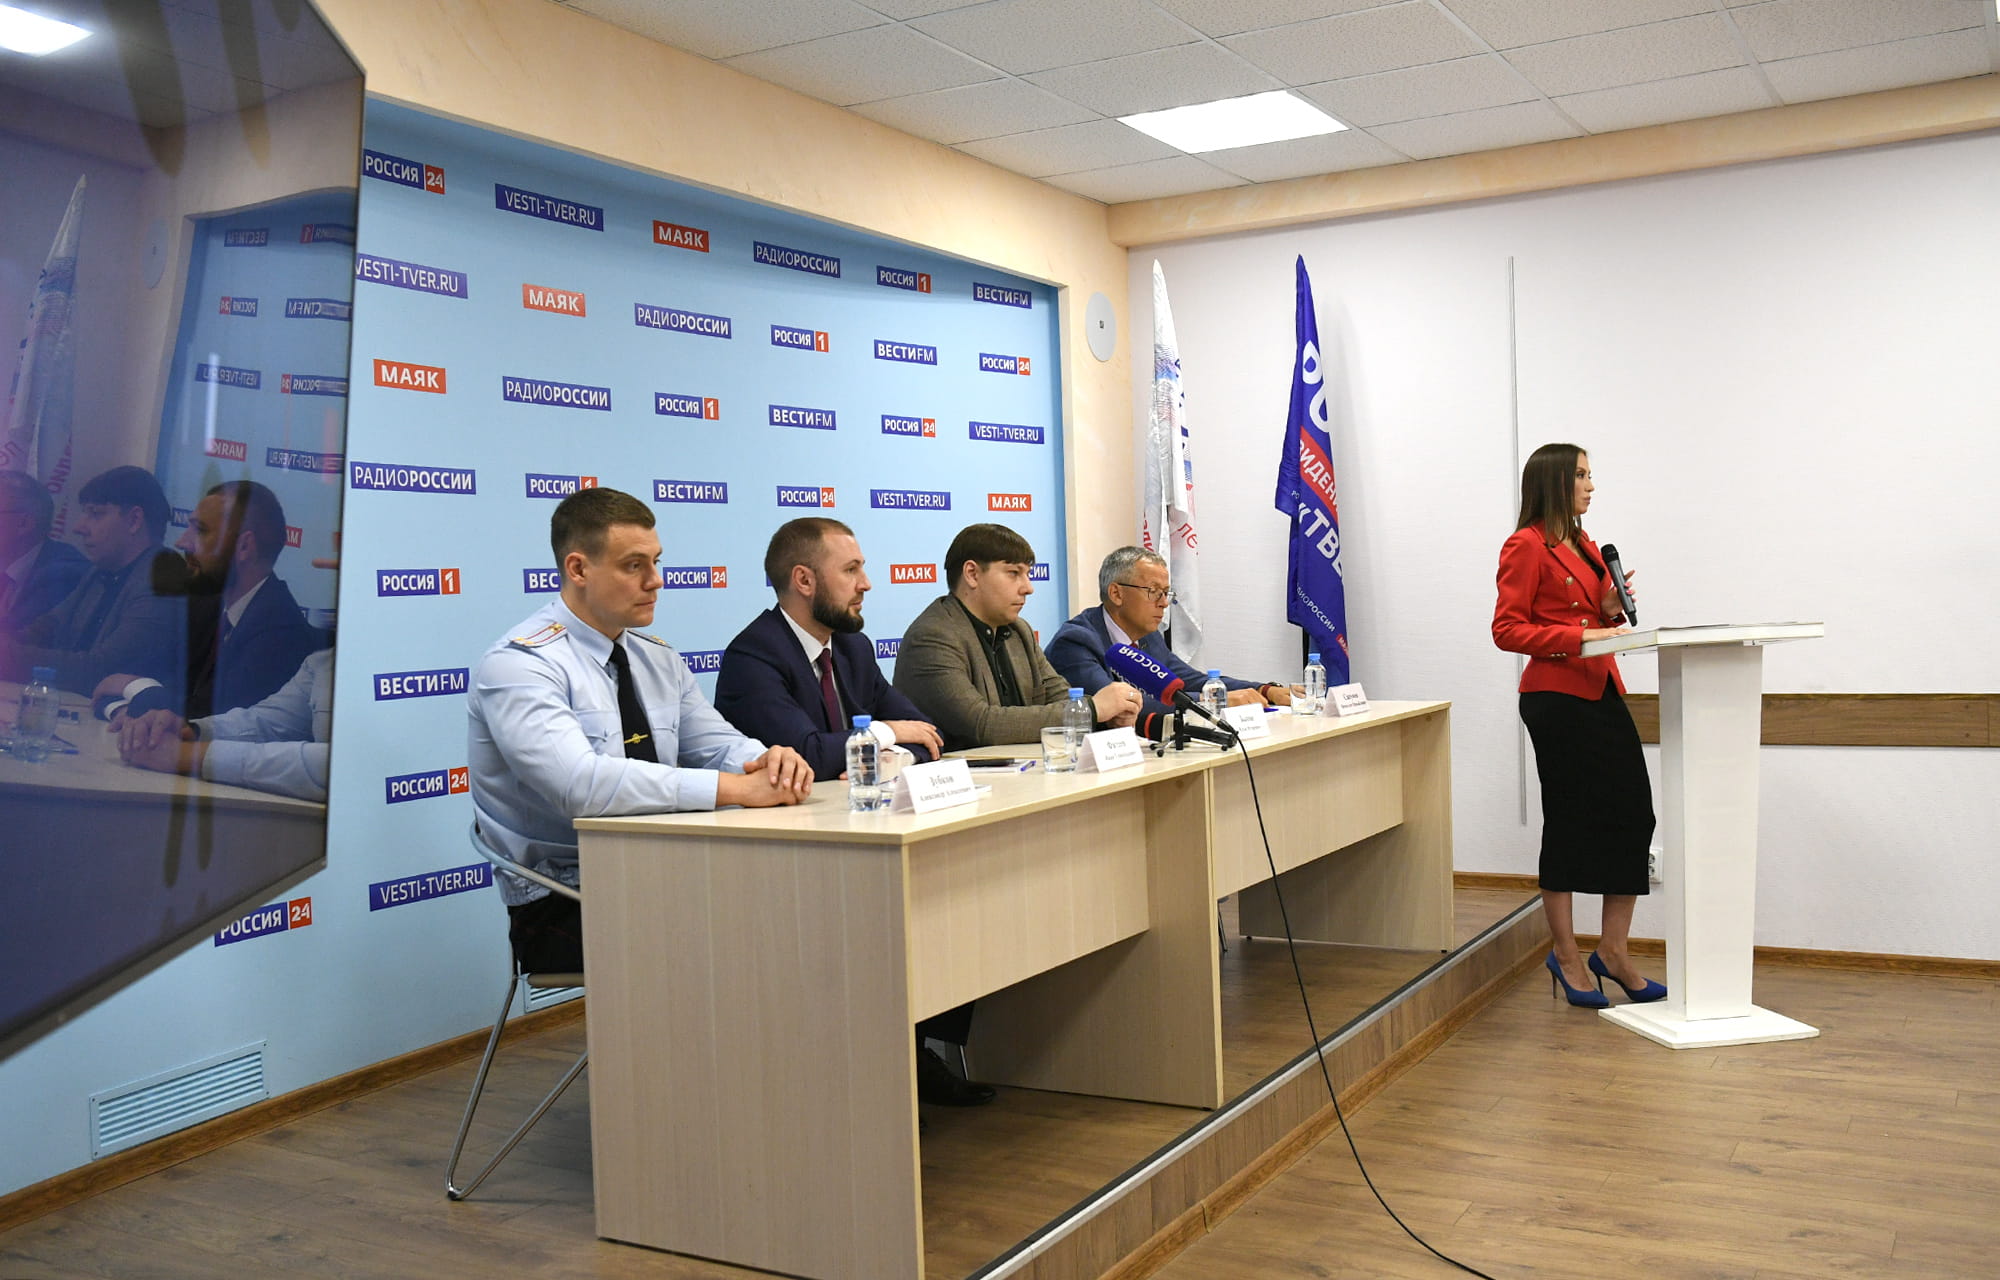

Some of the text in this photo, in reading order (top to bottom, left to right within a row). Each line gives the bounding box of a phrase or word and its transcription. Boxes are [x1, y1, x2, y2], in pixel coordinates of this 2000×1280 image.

[365, 155, 443, 188] РОССИЯ 24
[504, 190, 596, 226] VESTI-TVER.RU
[658, 226, 704, 248] МАЯК
[756, 246, 838, 275] РАДИОРОССИИ
[356, 258, 459, 293] VESTI-TVER.RU
[880, 270, 928, 291] РОССИЯ 1
[528, 289, 580, 312] МАЯК
[977, 286, 1029, 306] ВЕСТИFM
[637, 307, 729, 335] РАДИОРОССИИ
[774, 330, 826, 350] РОССИЯ 1
[878, 344, 933, 362] ВЕСТИFM
[982, 356, 1029, 372] РОССИЯ 24
[380, 364, 440, 389] МАЯК
[506, 380, 608, 407] РАДИОРОССИИ
[658, 397, 715, 418] РОССИЯ 1
[773, 408, 832, 428] ВЕСТИFM
[884, 418, 935, 434] РОССИЯ 24
[975, 425, 1038, 441] VESTI-TVER.RU
[355, 465, 472, 490] РАДИОРОССИИ
[530, 479, 576, 494] РОССИЯ
[657, 484, 724, 500] ВЕСТИFM
[780, 490, 834, 504] РОССИЯ 24
[877, 493, 945, 508] VESTI-TVER.RU
[991, 496, 1028, 509] МАЯК
[382, 570, 455, 592] РОССИЯ 1
[529, 572, 559, 589] ВЕС
[666, 571, 726, 585] РОССИЯ 24
[894, 567, 933, 581] МАЯК
[1118, 646, 1169, 680] РОССИЯ
[380, 672, 465, 696] ВЕСТИFM
[391, 771, 468, 797] РОССИЯ 24
[380, 867, 484, 905] VESTI-TVER.RU
[291, 903, 311, 922] 24
